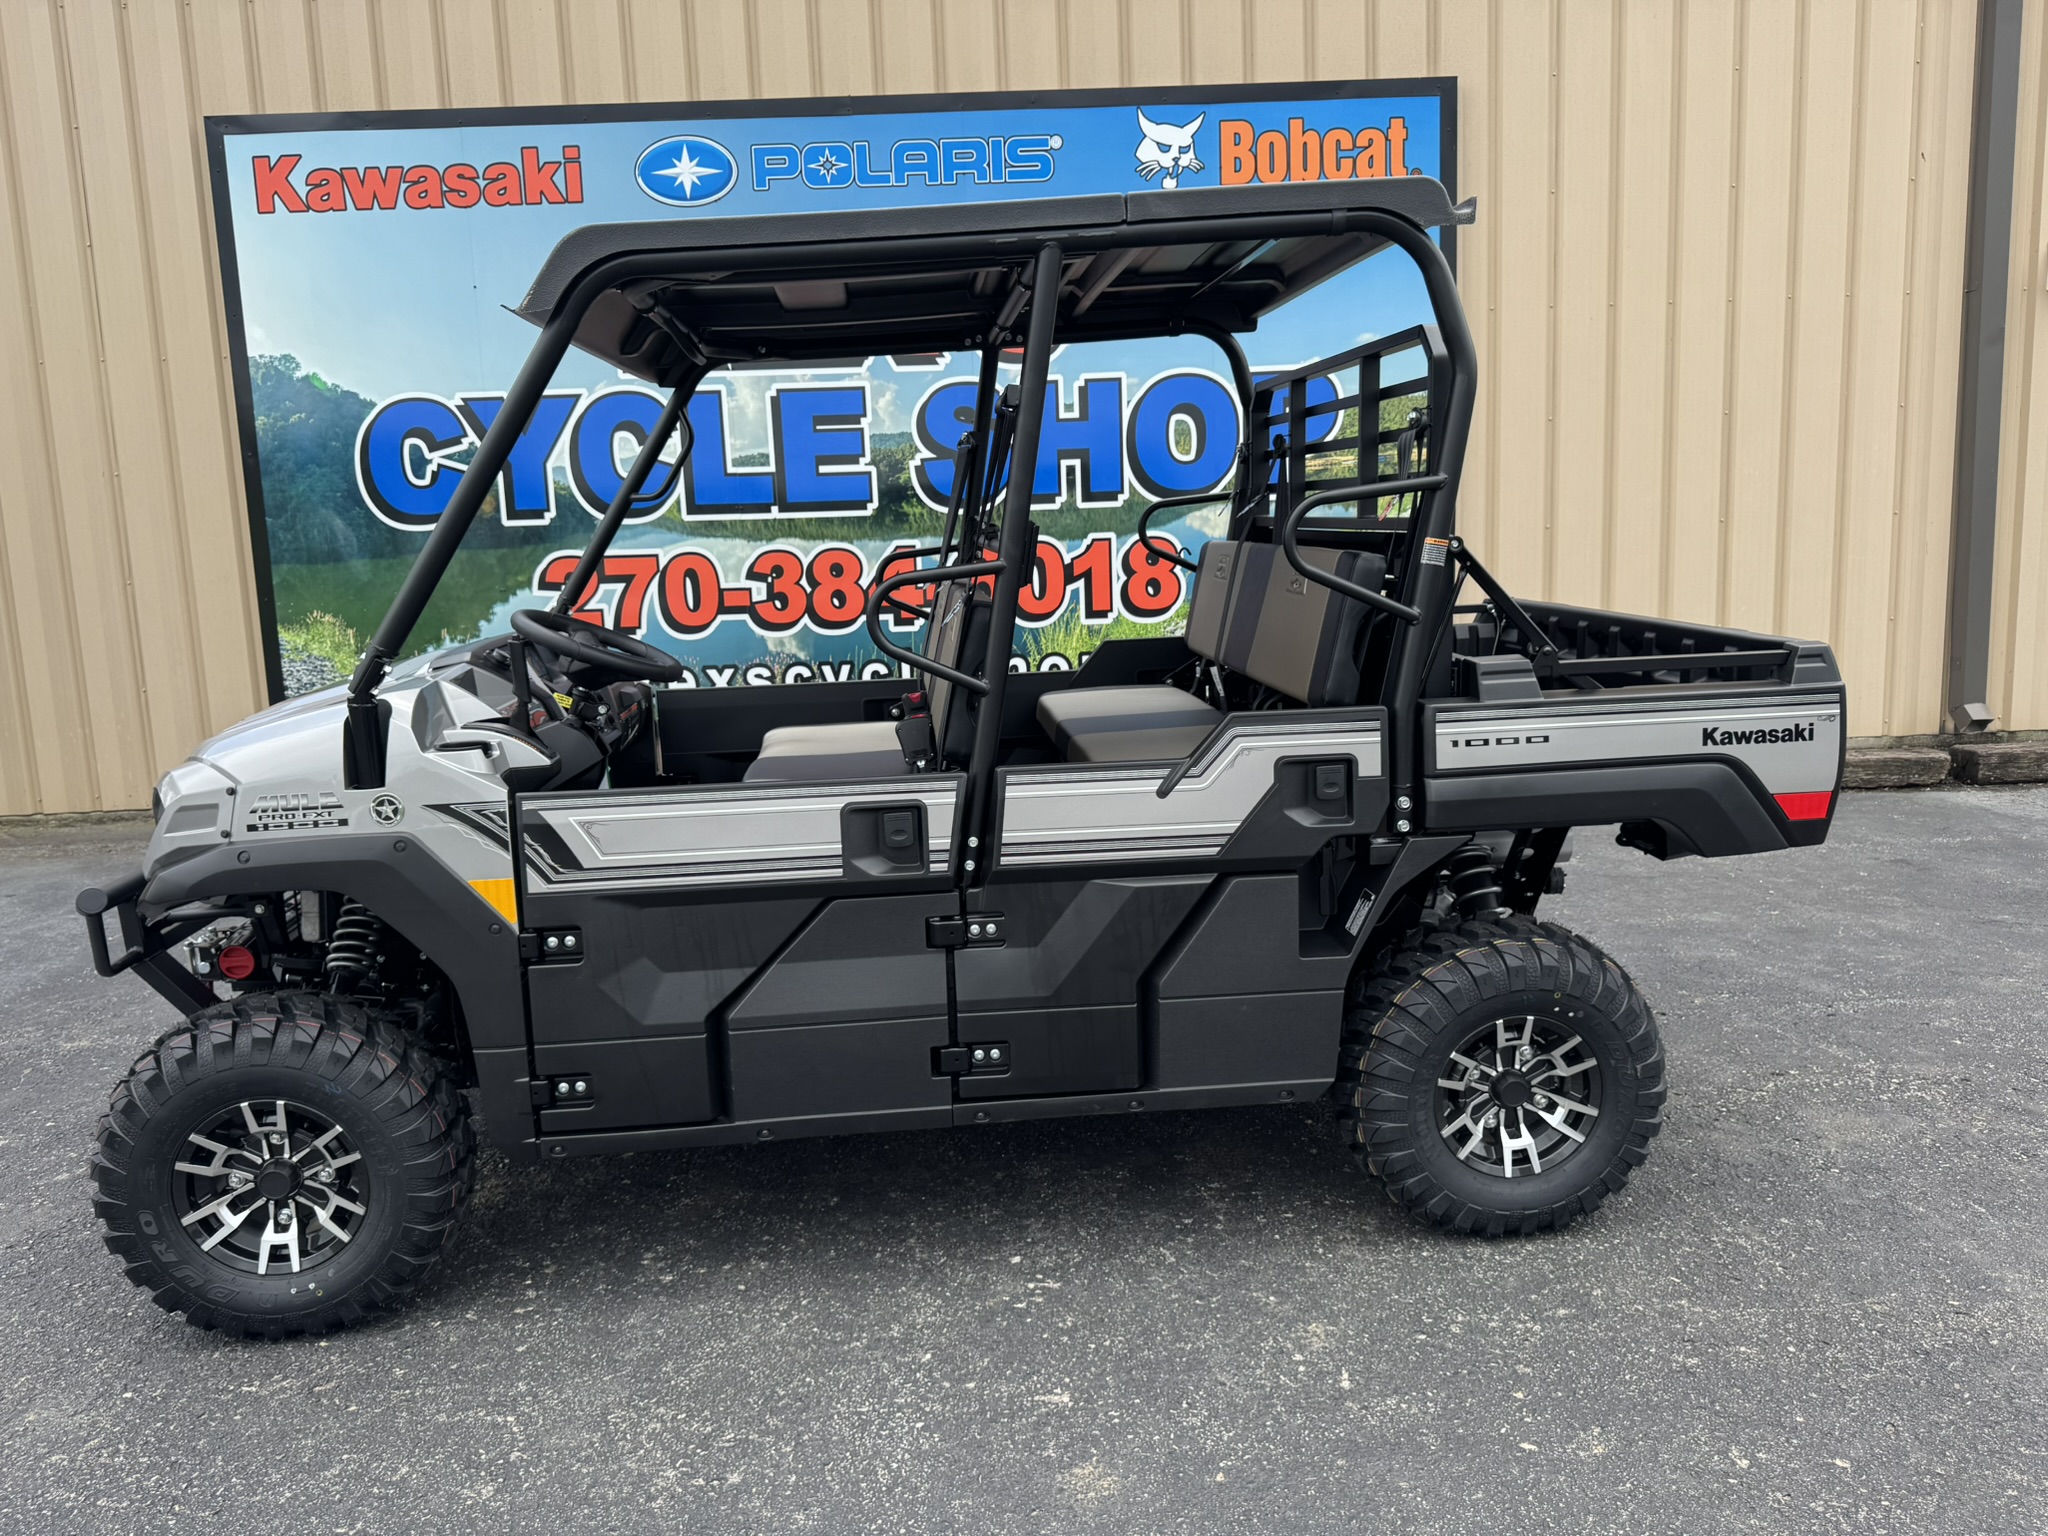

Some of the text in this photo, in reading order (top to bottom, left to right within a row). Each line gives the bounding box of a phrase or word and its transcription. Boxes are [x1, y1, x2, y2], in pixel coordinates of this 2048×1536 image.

[251, 145, 584, 215] Kawasaki
[752, 134, 1056, 191] POLARIS
[1218, 116, 1409, 186] Bobcat
[358, 386, 875, 527] CYCLE
[1449, 734, 1550, 749] 1000
[1702, 722, 1815, 747] Kawasaki
[249, 791, 344, 814] MULE
[136, 1209, 240, 1303] DURO
